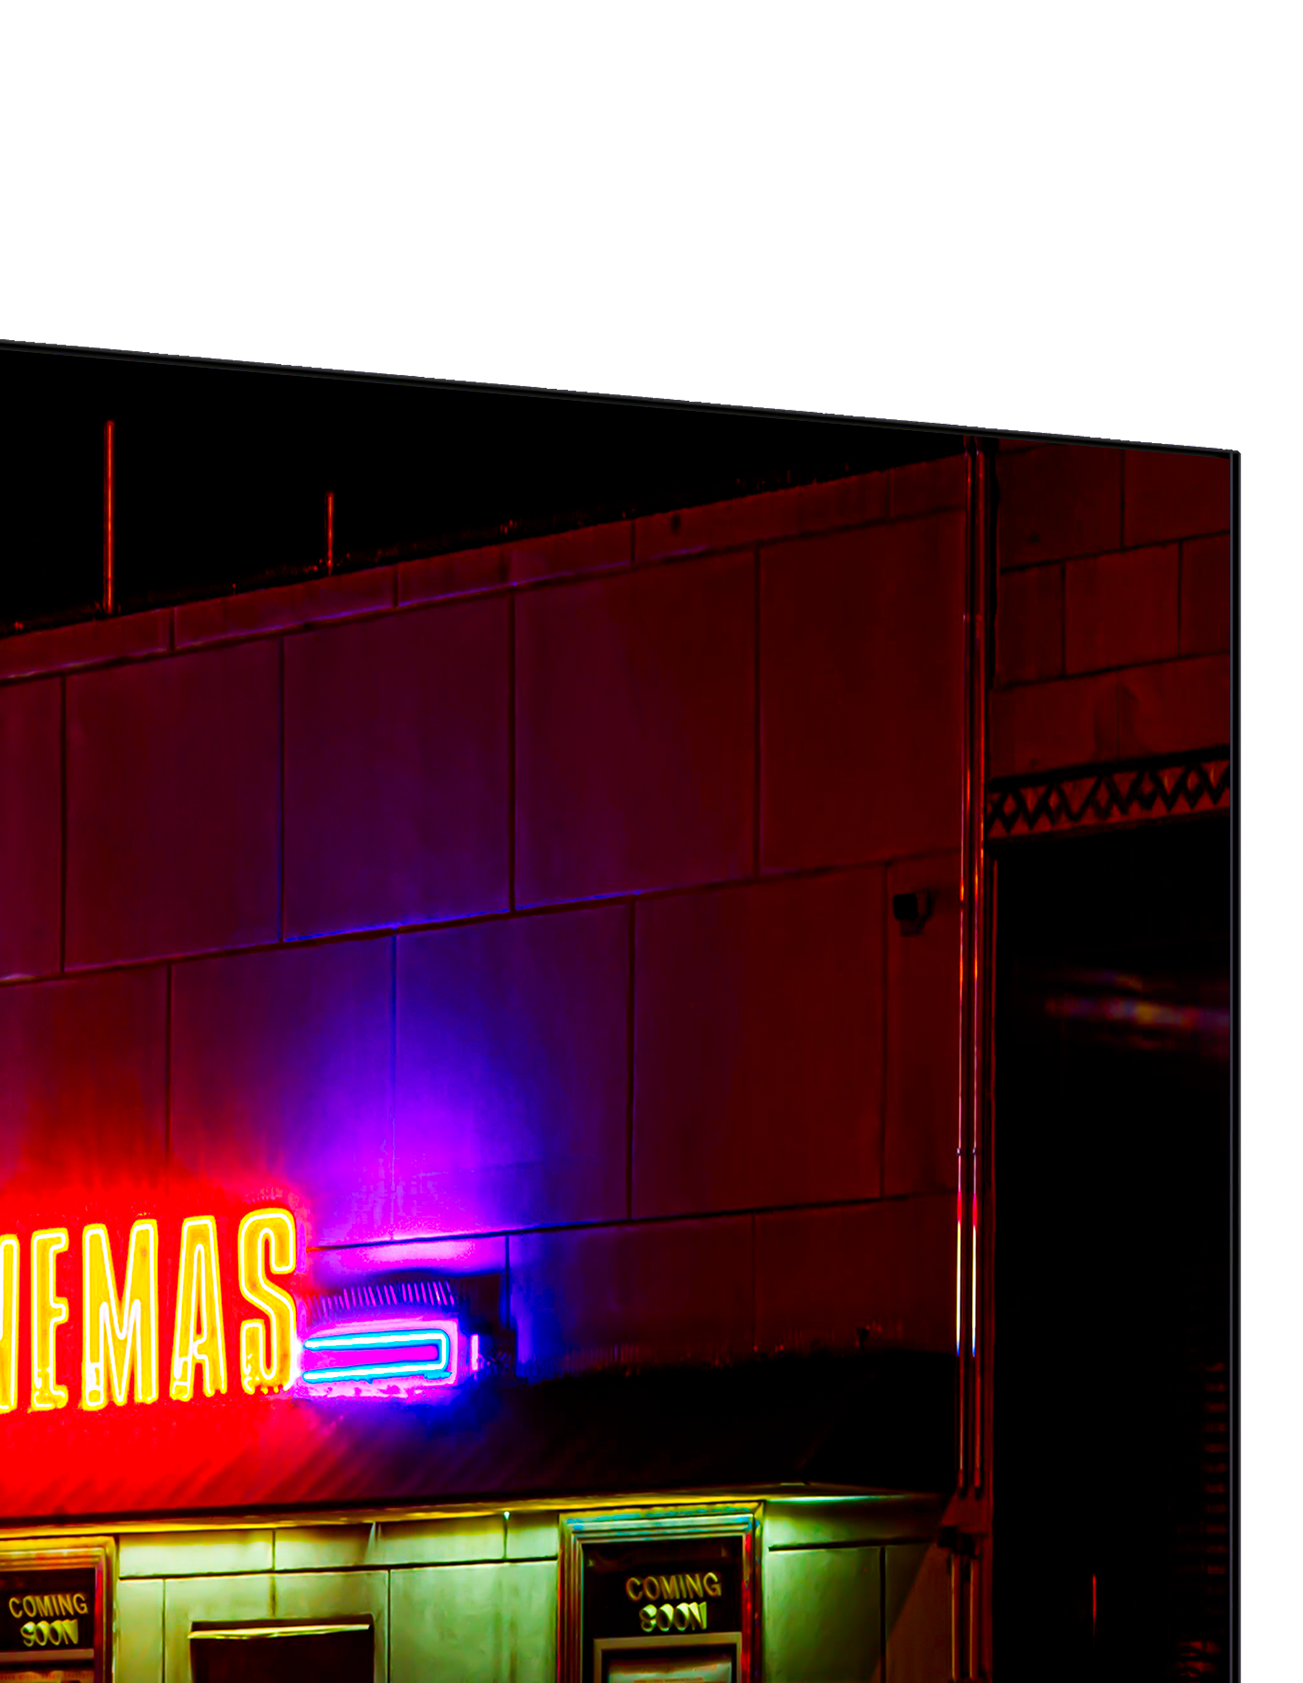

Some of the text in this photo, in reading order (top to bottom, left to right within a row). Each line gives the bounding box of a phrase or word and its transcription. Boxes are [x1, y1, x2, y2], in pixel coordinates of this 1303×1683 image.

[625, 1571, 723, 1602] COMING
[8, 1593, 88, 1618] COMING
[639, 1601, 708, 1632] SOON
[20, 1619, 79, 1648] SOON
